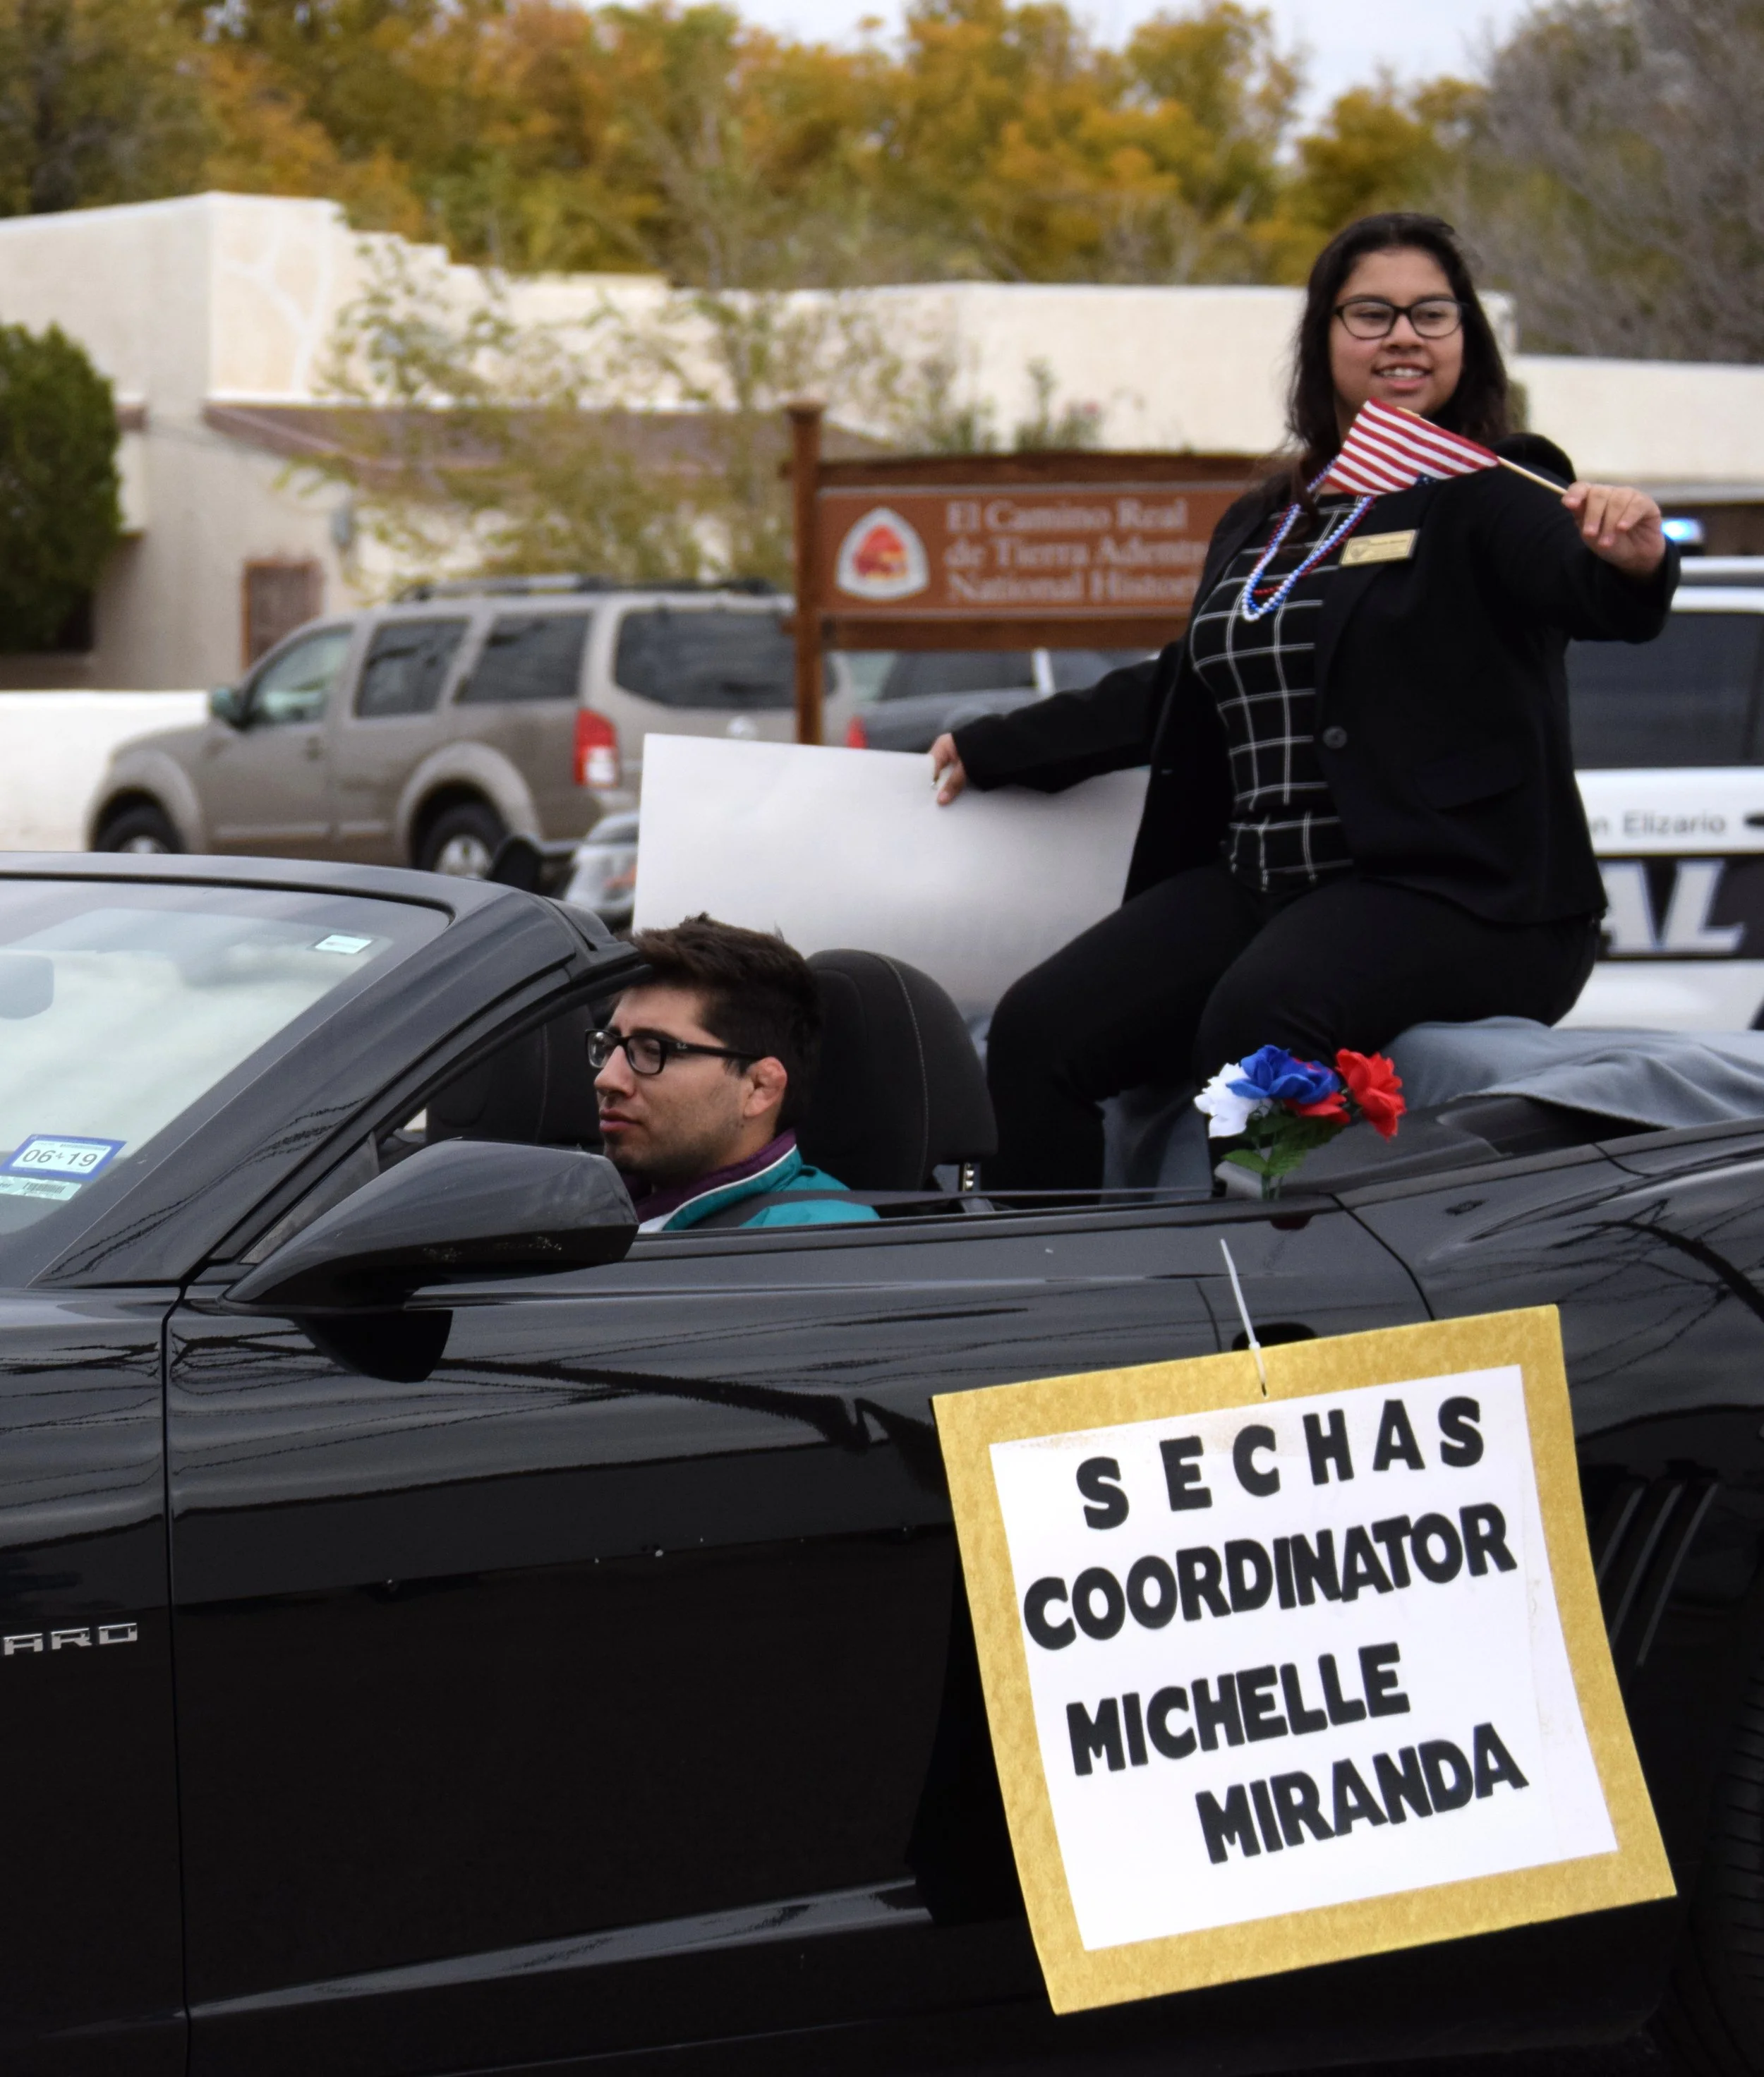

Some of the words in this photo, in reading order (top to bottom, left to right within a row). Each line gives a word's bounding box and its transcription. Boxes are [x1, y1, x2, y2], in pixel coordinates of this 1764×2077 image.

[946, 500, 981, 532] El
[985, 499, 1111, 531] Camino
[1116, 497, 1188, 530] Real
[944, 538, 986, 567] de
[989, 537, 1089, 567] Tierra
[1097, 536, 1209, 566] Adentr
[947, 571, 1082, 604] National
[1090, 570, 1200, 602] Histori
[1624, 810, 1727, 837] Elizario
[1596, 858, 1746, 952] AL
[23, 1149, 56, 1163] 06
[66, 1152, 98, 1167] 19
[1076, 1396, 1485, 1530] SECHAS
[1023, 1502, 1517, 1651] COORDINATOR
[1065, 1642, 1410, 1776] MICHELLE
[1195, 1723, 1530, 1864] MIRANDA
